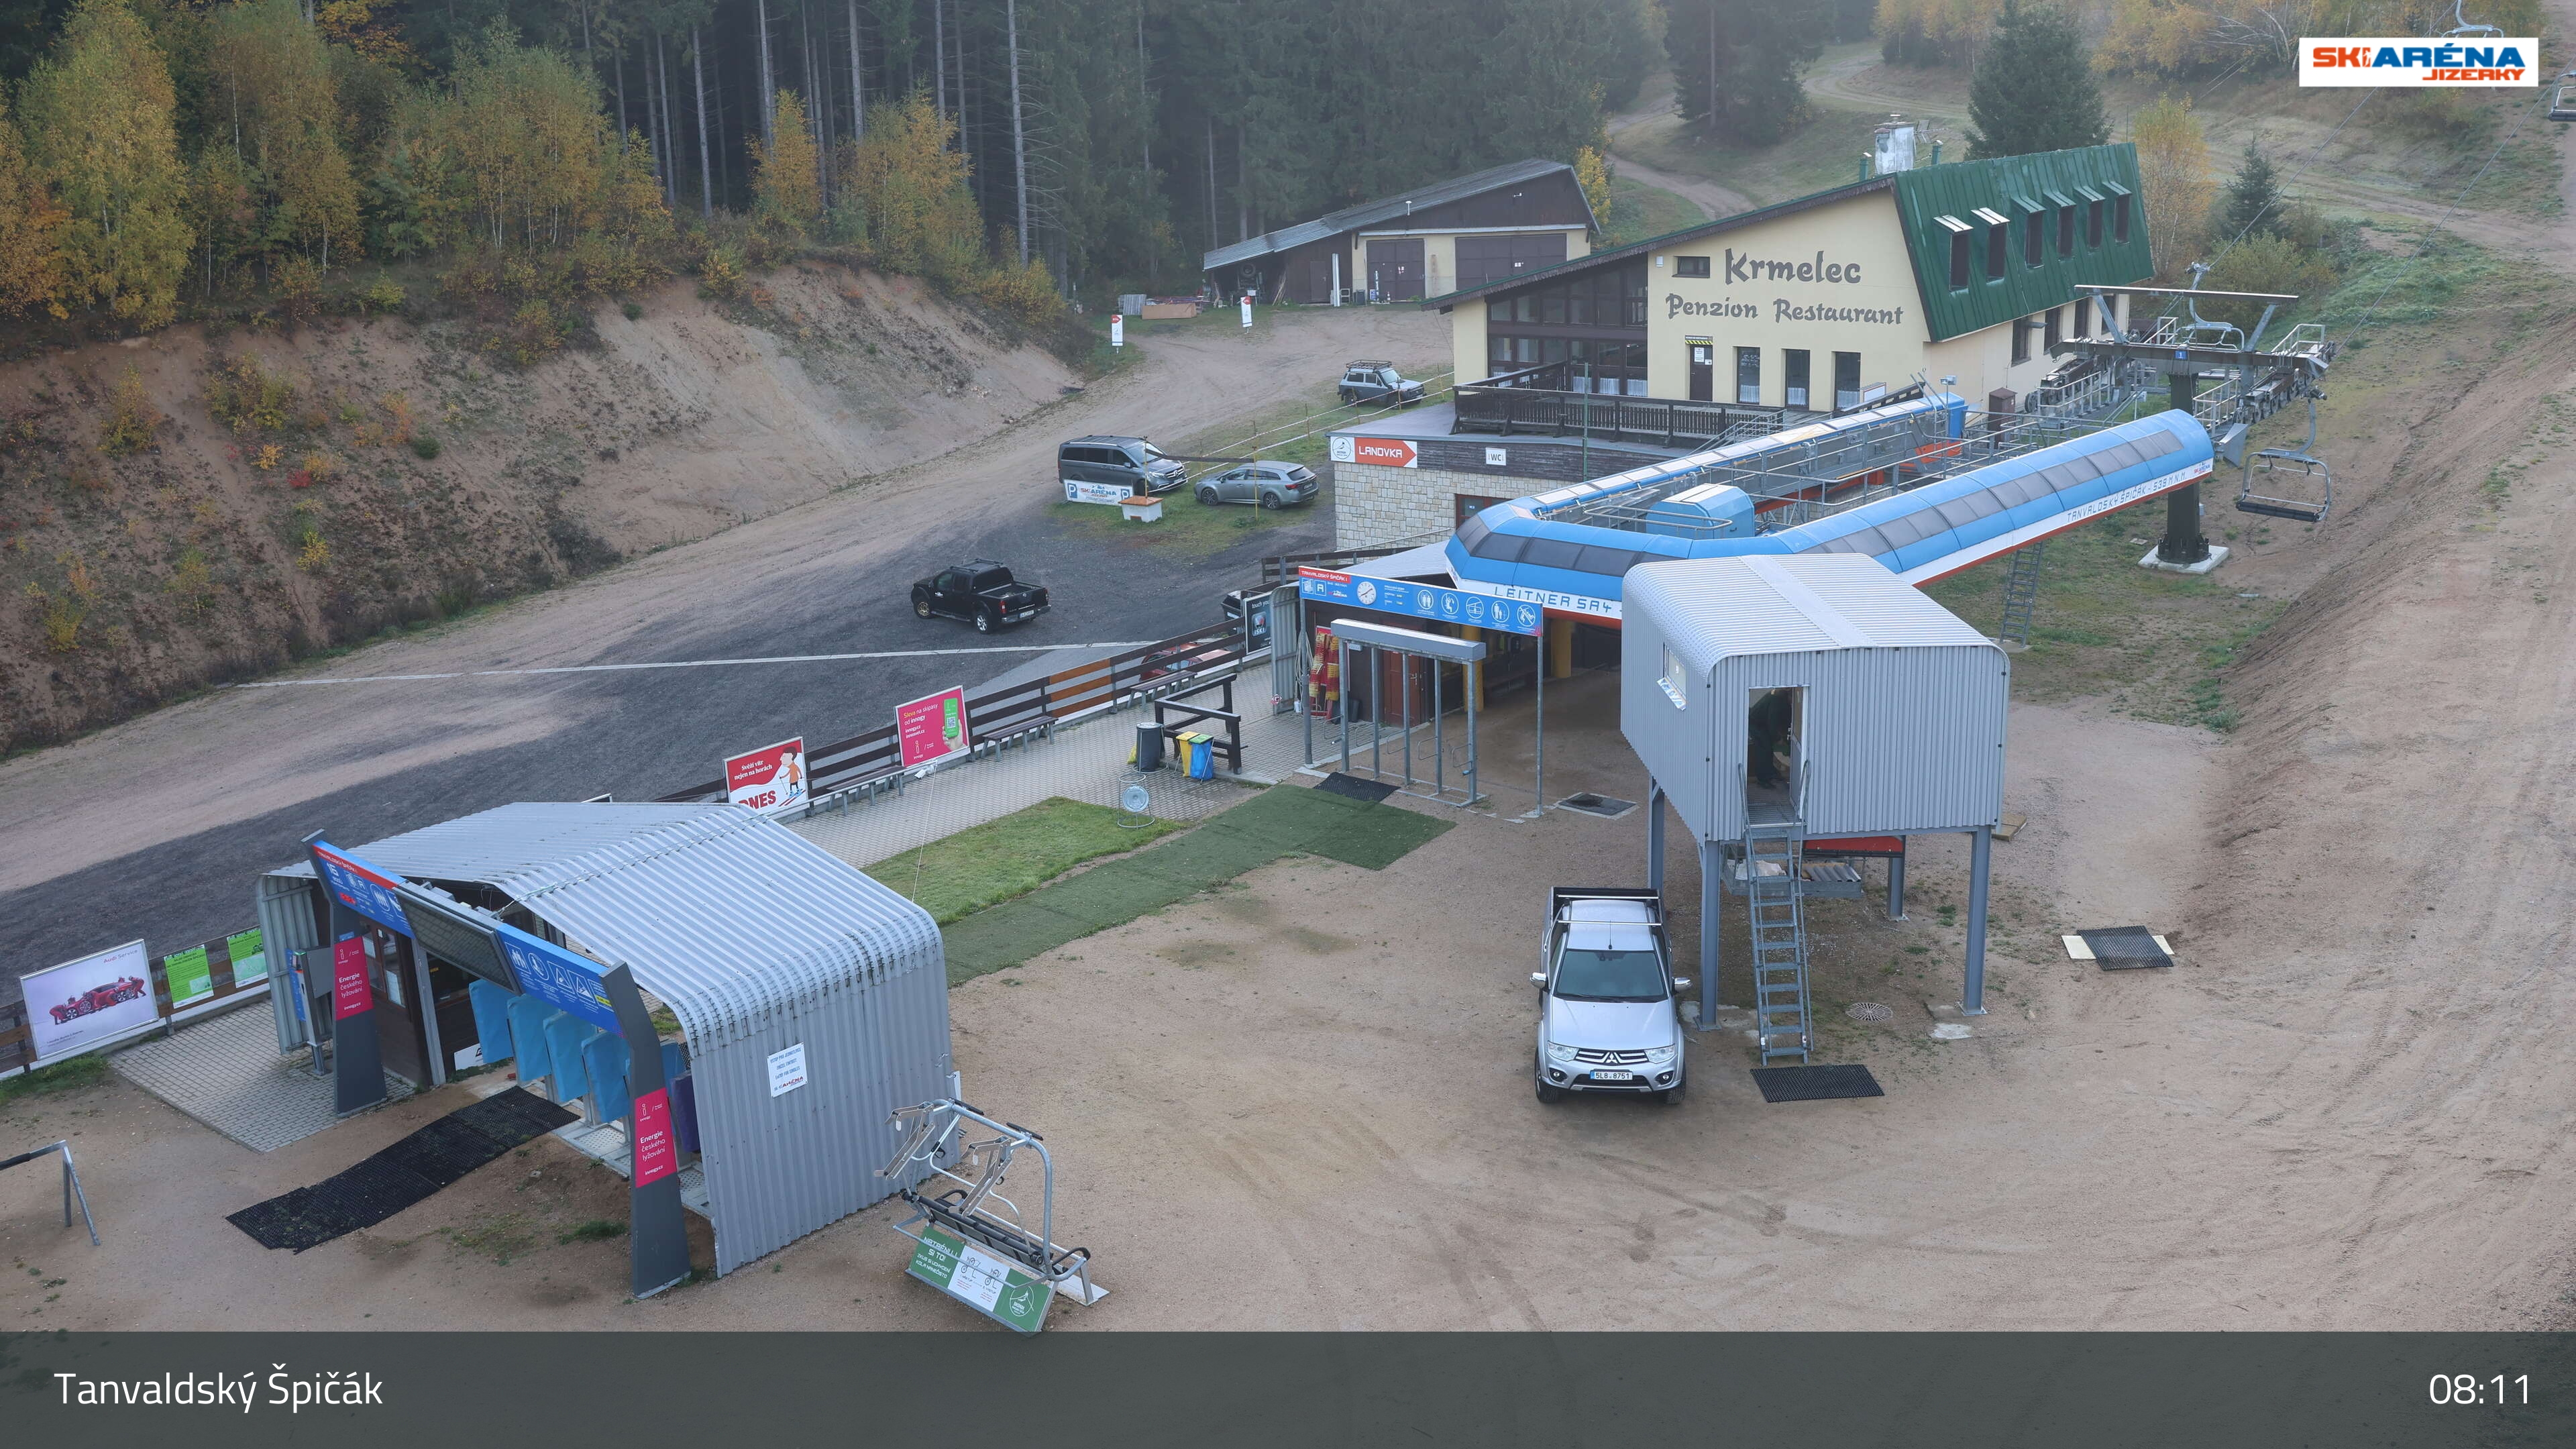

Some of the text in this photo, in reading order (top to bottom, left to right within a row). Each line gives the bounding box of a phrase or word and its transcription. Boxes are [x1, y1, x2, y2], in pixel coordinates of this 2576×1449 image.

[1725, 248, 1862, 285] Krmelec
[1665, 293, 1904, 325] Penzion Restaurant
[1358, 445, 1403, 458] LANOVKA
[1493, 586, 1570, 607] LEITNER
[339, 973, 360, 983] Energie
[340, 979, 362, 991] českého
[640, 1130, 663, 1144] Energie
[641, 1138, 665, 1152] českého
[642, 1146, 665, 1162] lyžování
